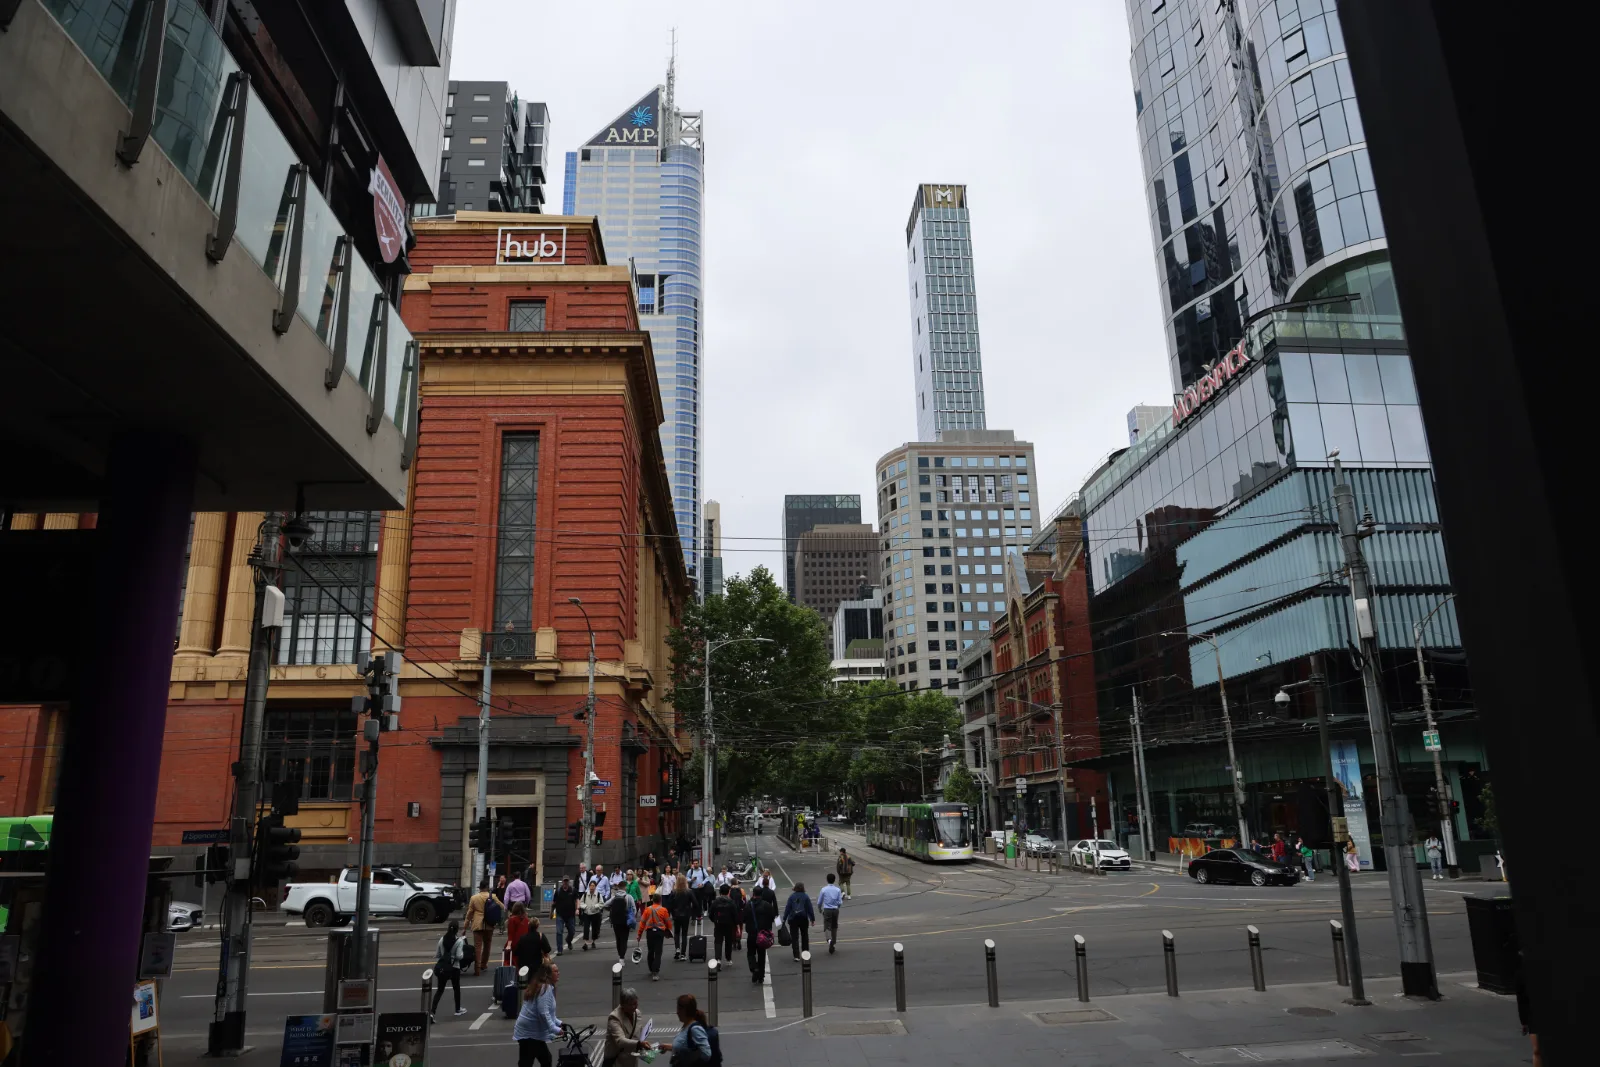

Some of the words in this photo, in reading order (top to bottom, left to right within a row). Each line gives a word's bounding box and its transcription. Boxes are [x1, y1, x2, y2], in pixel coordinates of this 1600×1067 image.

[605, 127, 655, 143] AMP
[376, 172, 404, 228] SCHNITZ
[505, 232, 558, 258] hub
[1172, 337, 1251, 429] MÖVENPICK
[640, 796, 655, 805] hub
[188, 831, 218, 841] Spencer
